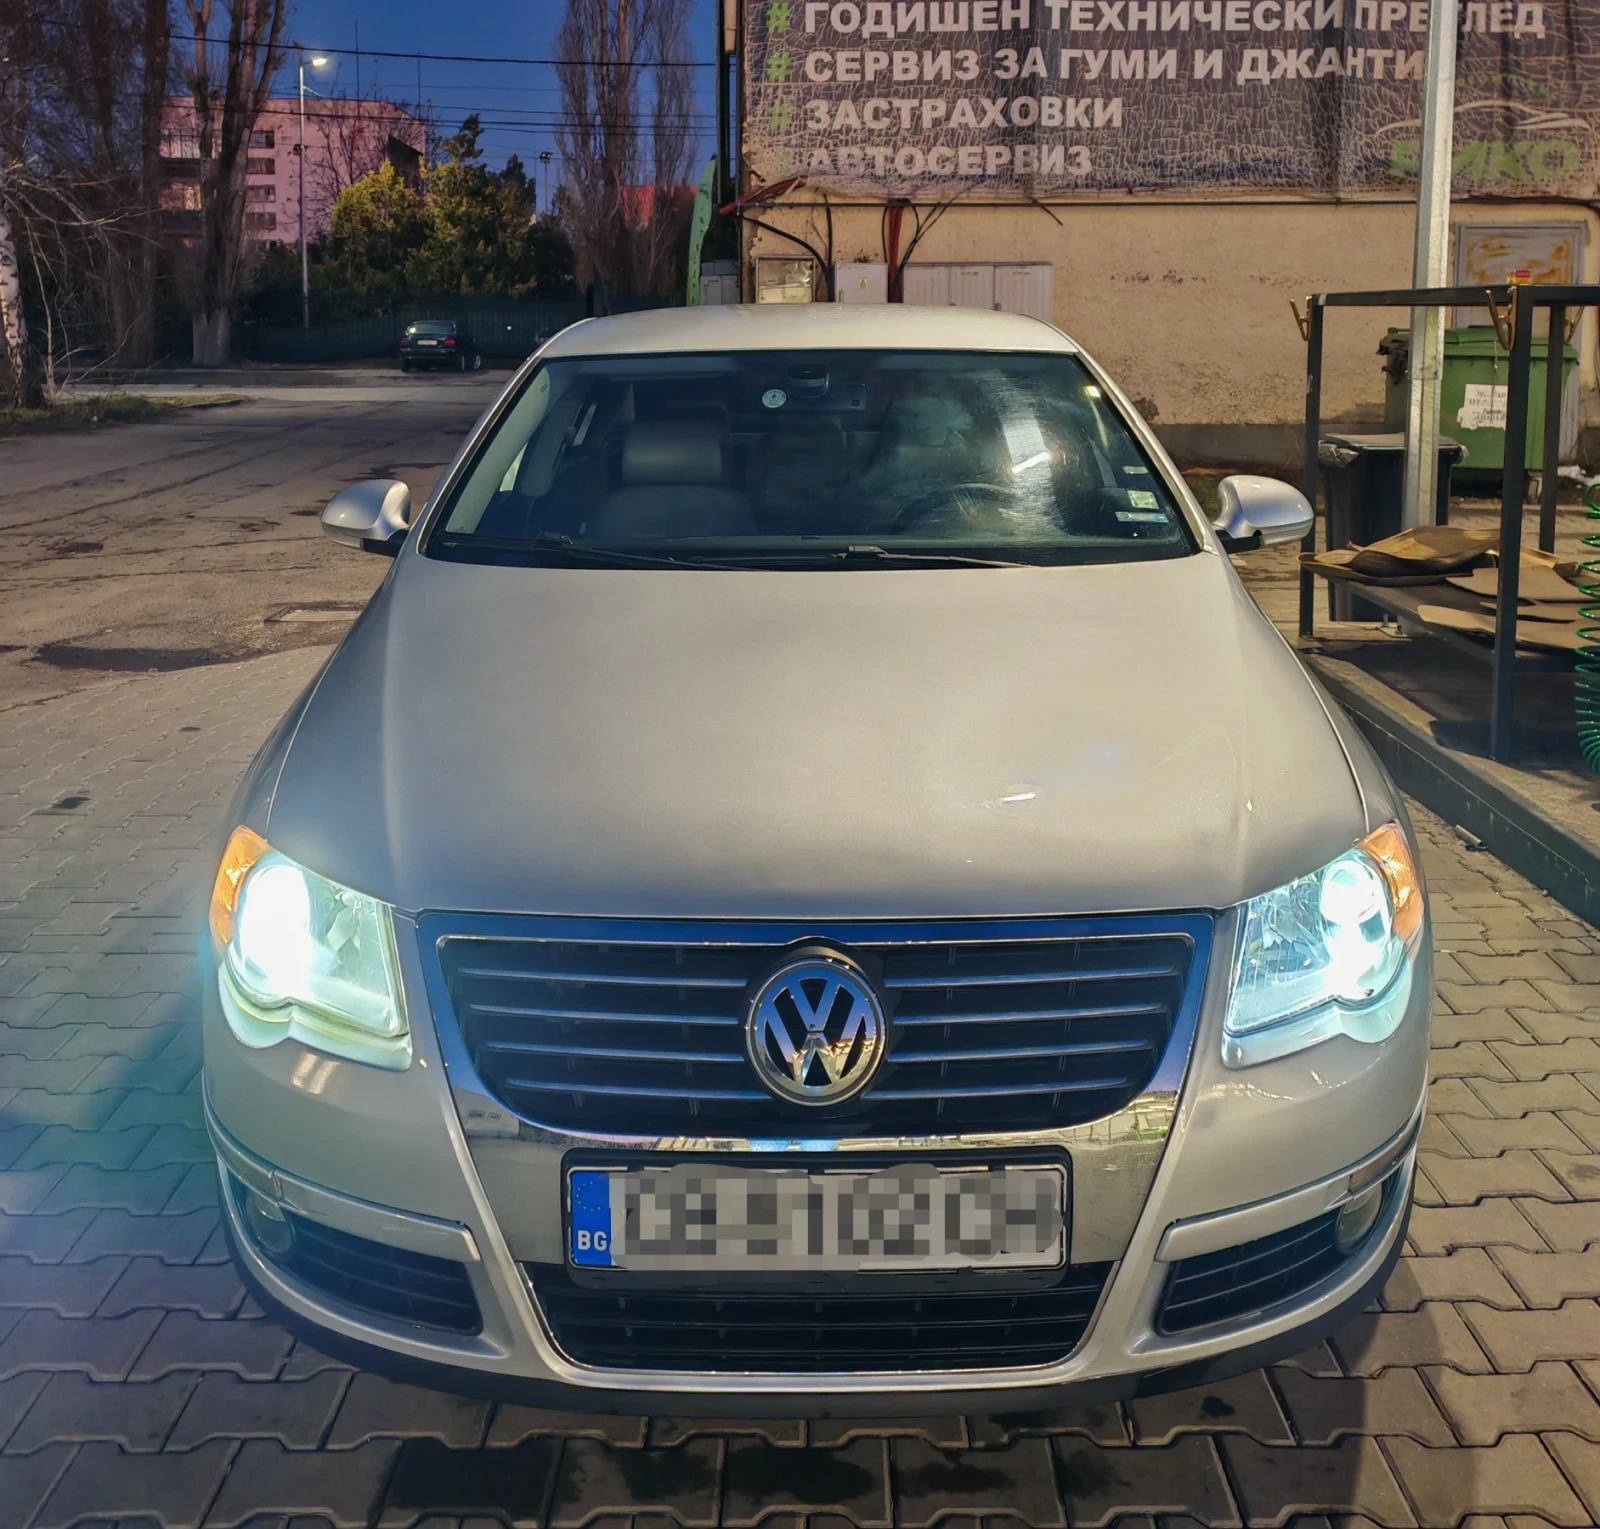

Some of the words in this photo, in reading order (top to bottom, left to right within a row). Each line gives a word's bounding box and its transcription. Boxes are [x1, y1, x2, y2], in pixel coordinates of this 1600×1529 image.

[805, 0, 1030, 38] ГОДИШЕН
[1045, 0, 1343, 31] ТЕХНИЧЕСКИ
[1356, 1, 1546, 39] ПРЕЛЕД
[805, 50, 980, 81] СЕРВИЗ
[994, 47, 1048, 79] ЗА
[1060, 49, 1178, 80] ГУМИ
[1194, 49, 1223, 79] И
[1237, 46, 1425, 85] ДЖАНТИ
[805, 96, 1123, 130] ЗАСТРАХОВКИ
[808, 145, 1092, 176] АВТОСЕРВИЗ
[577, 1229, 608, 1251] BG
